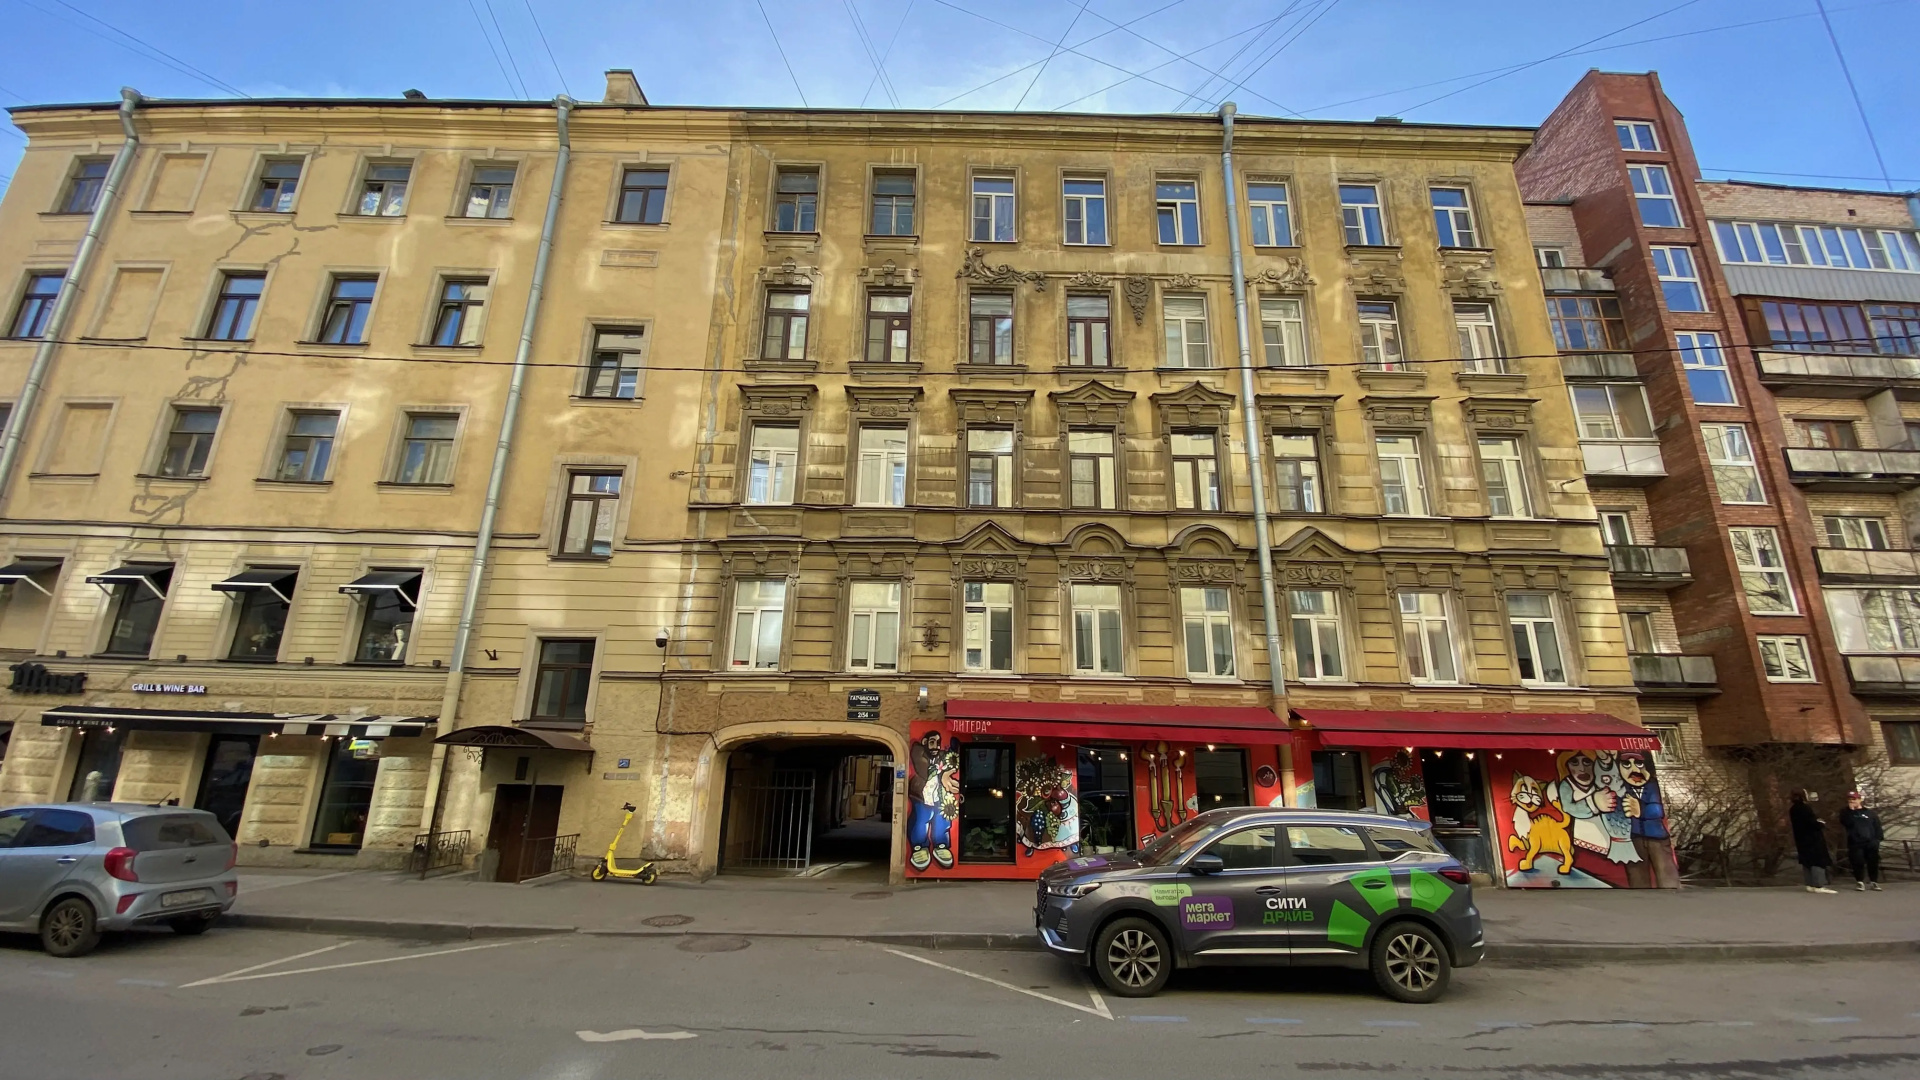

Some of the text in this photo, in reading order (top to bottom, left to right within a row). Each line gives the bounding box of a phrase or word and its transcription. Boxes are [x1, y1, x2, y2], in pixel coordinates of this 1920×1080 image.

[131, 683, 205, 693] GRILL & WINE BAR
[1185, 902, 1215, 913] мега
[1265, 897, 1307, 910] СИТИ
[1186, 912, 1231, 924] маркет
[1262, 909, 1315, 925] ДРАЙВ
